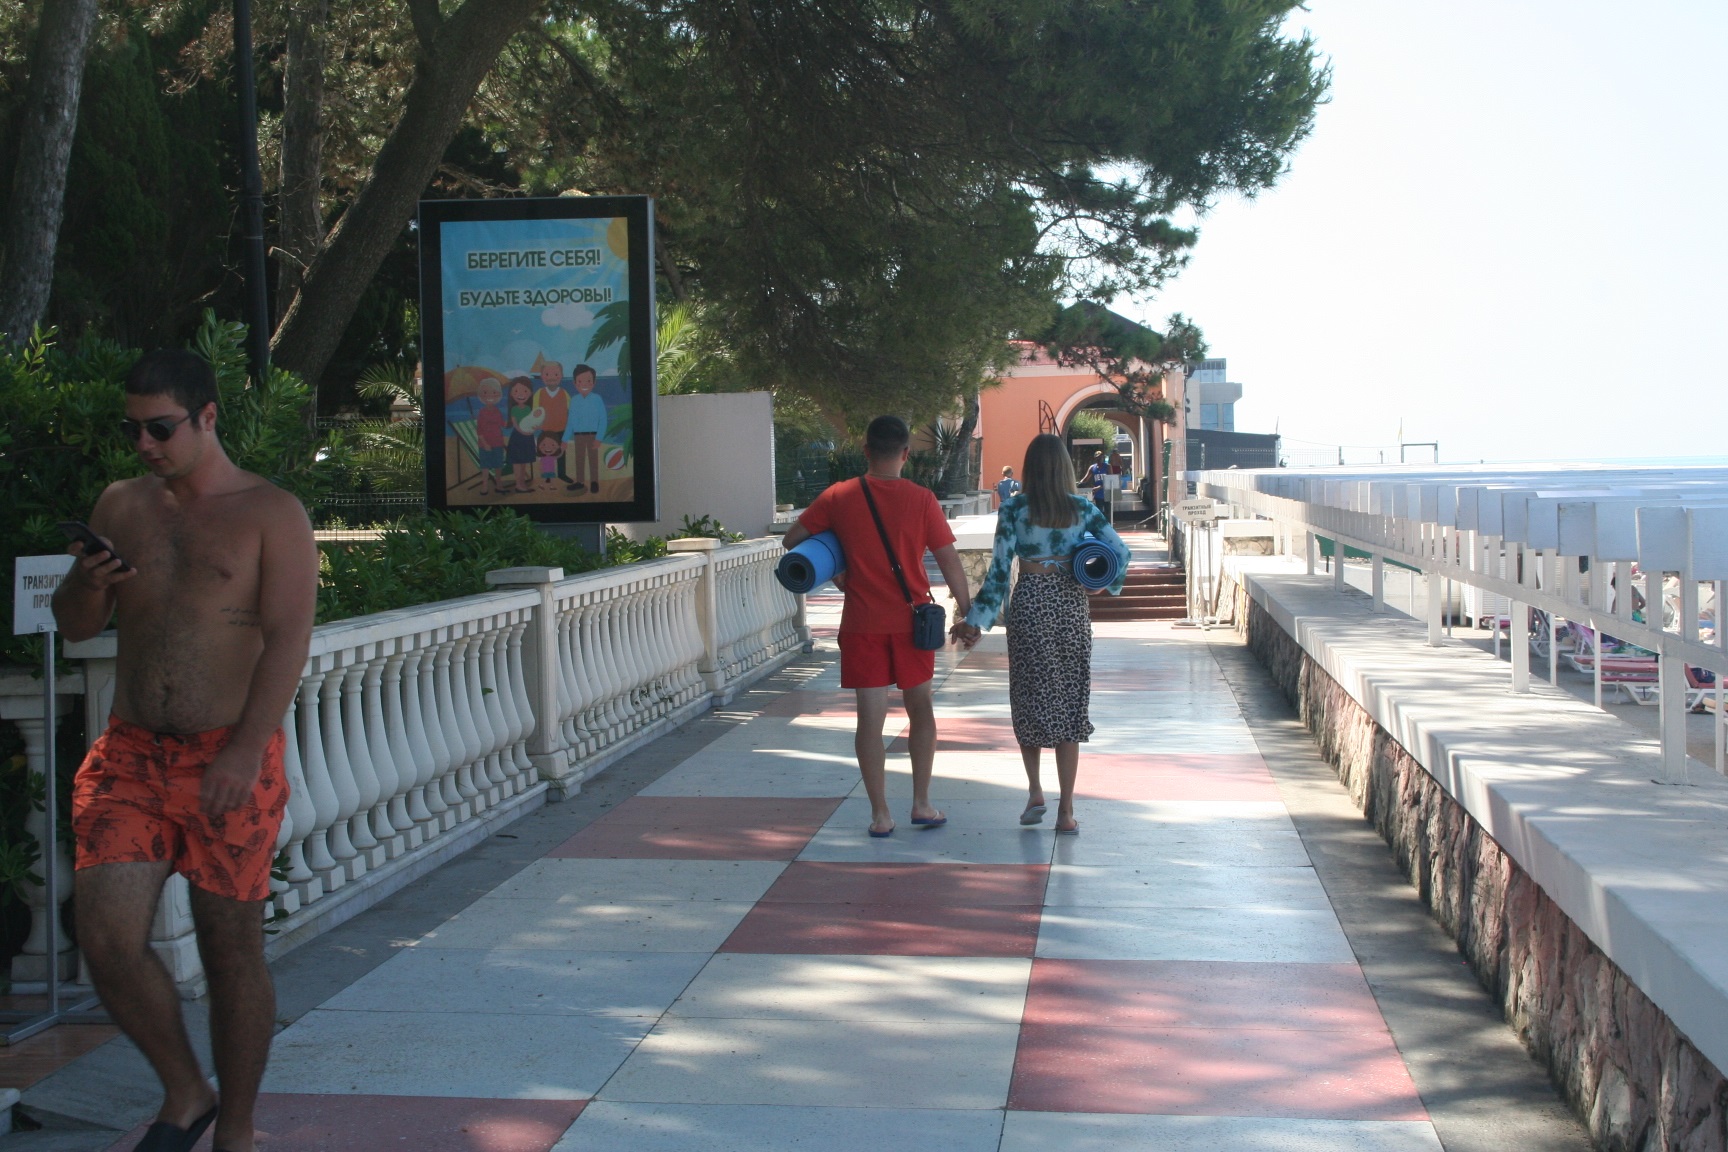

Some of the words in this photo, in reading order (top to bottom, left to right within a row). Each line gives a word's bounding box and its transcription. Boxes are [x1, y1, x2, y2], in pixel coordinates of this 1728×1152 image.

[468, 251, 546, 269] БЕРЕГИТЕ
[550, 249, 601, 267] СЕБЯ!
[460, 290, 520, 308] БУДЬТЕ
[523, 287, 612, 307] ЗДОРОВЫ!
[23, 574, 66, 590] ТРАНЗИТН
